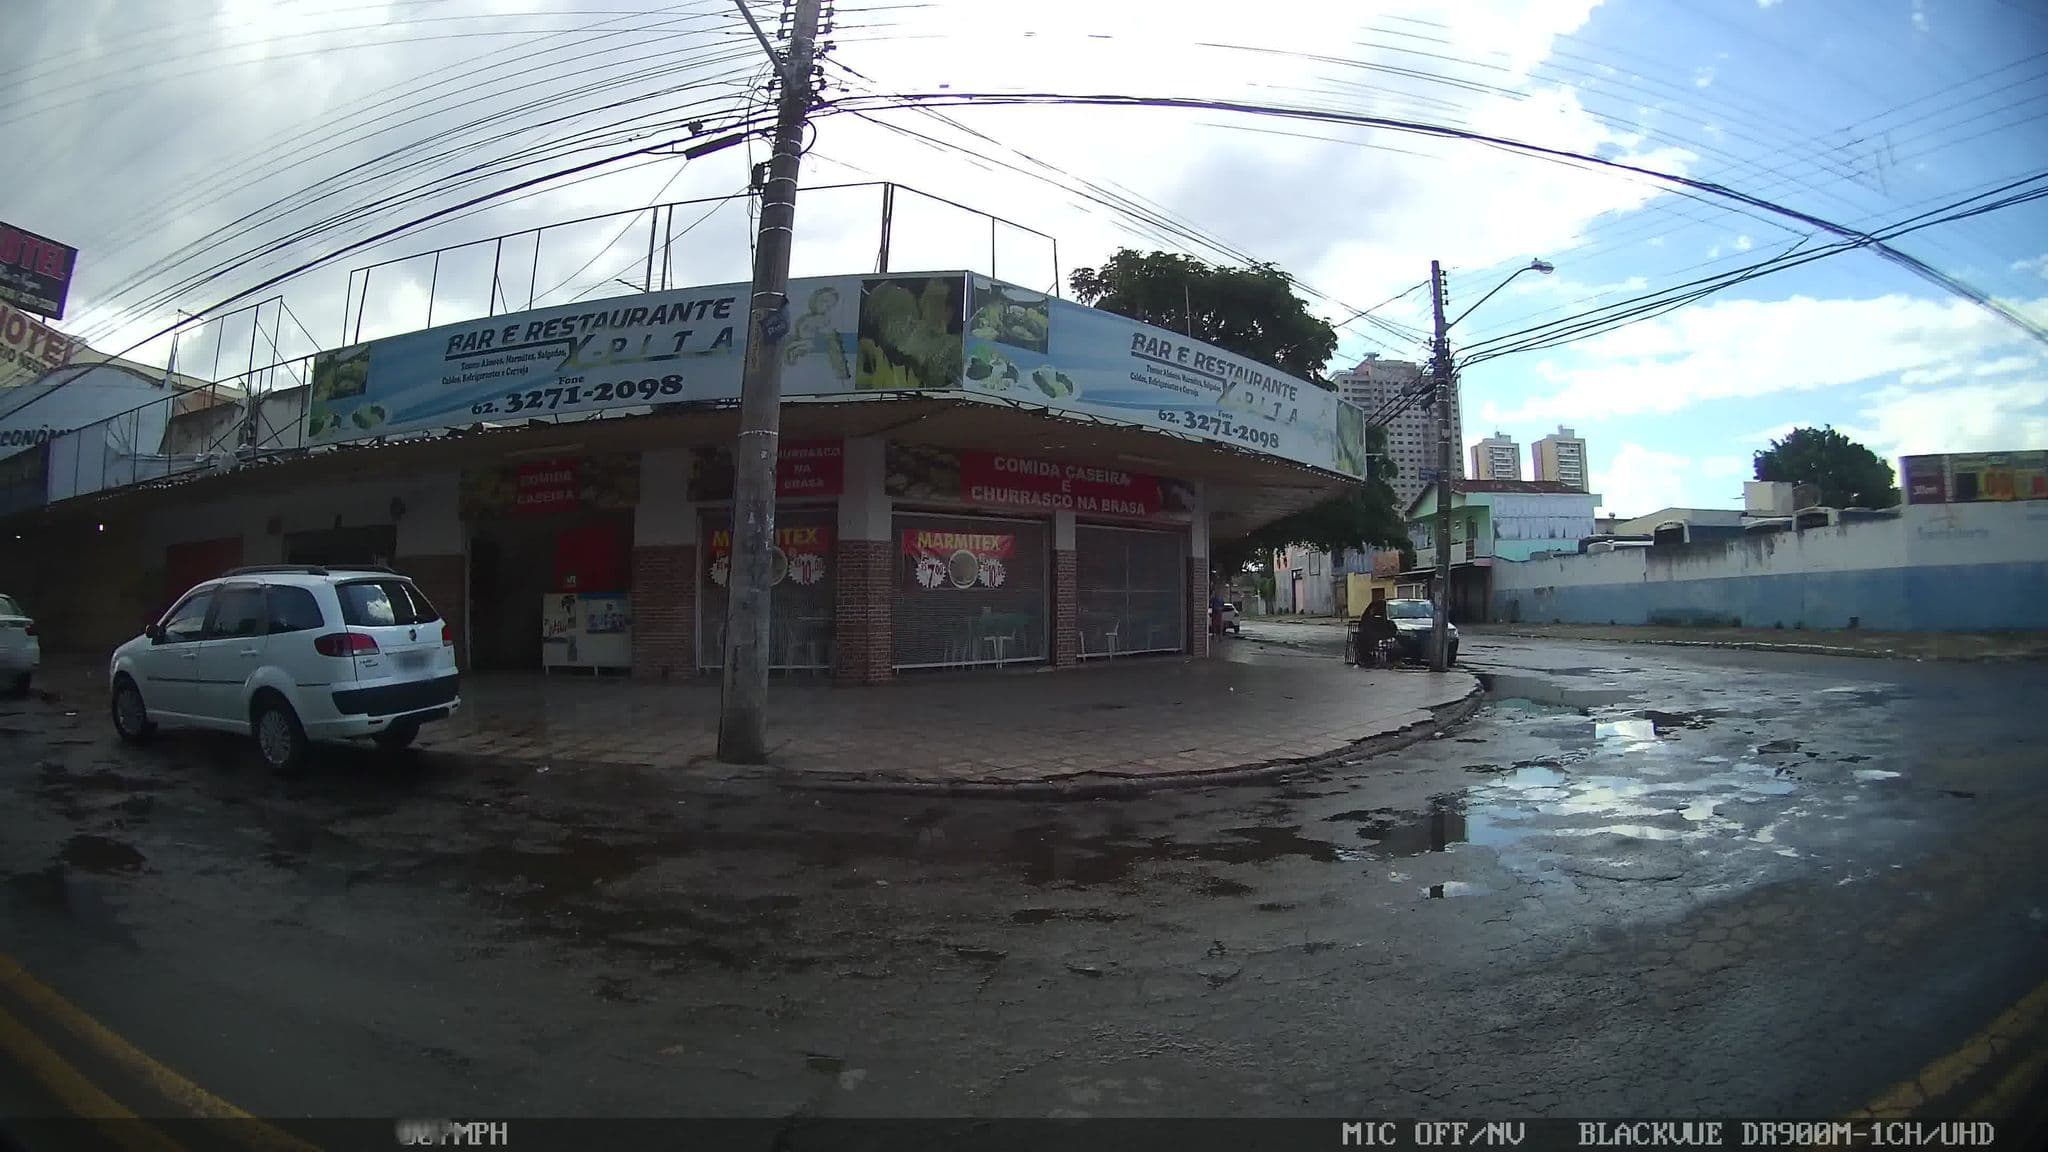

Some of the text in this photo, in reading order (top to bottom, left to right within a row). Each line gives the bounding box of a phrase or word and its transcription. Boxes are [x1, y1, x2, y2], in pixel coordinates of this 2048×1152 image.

[446, 328, 496, 354] BAR
[502, 324, 520, 342] E
[525, 297, 736, 341] RESTAURANTE
[558, 374, 585, 386] Fone
[1132, 333, 1298, 403] BAR E RESTAURANTE
[504, 373, 684, 414] 3271-2098
[1184, 410, 1279, 449] 3271-2098
[994, 456, 1132, 486] COMIDA CASEIRA
[971, 485, 1146, 516] CHURRASCO NA BRASA
[917, 532, 1000, 551] MARMITEX
